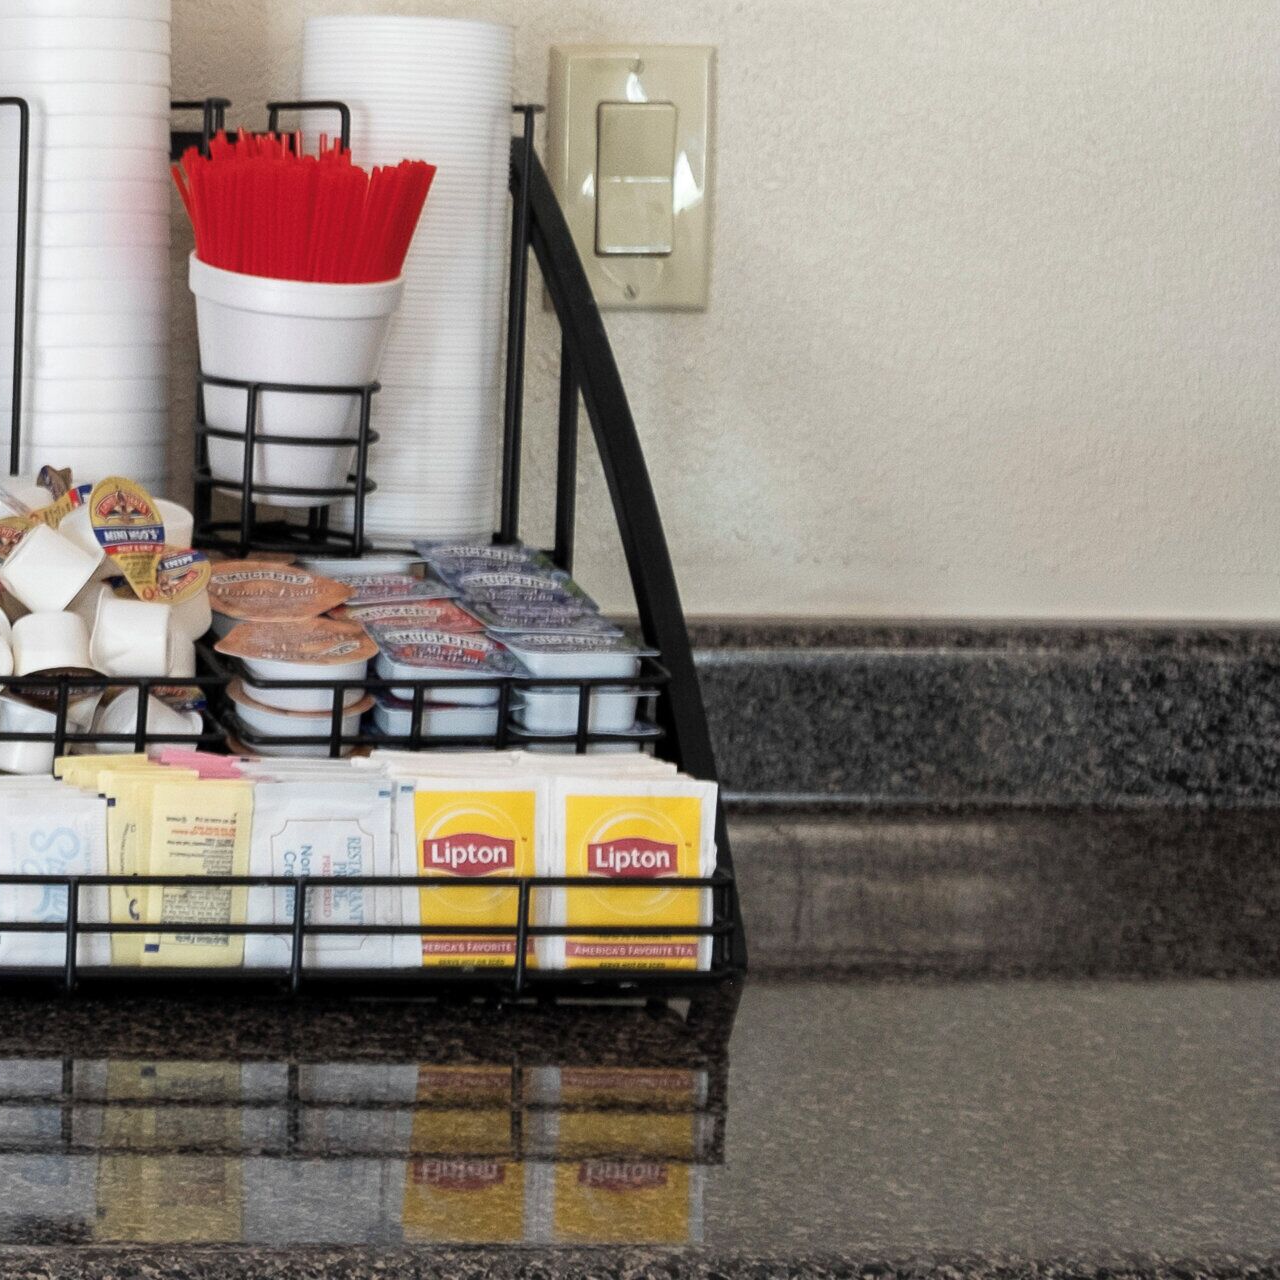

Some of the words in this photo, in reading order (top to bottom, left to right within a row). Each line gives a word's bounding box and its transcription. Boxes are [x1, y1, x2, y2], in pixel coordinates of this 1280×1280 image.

[431, 841, 508, 869] Lipton
[595, 845, 671, 873] Lipton
[347, 836, 364, 922] RESTARANT
[466, 941, 513, 953] FAVORITE
[574, 946, 627, 957] AMERICA'S
[628, 946, 674, 957] FAVORITE
[675, 946, 694, 957] TEA
